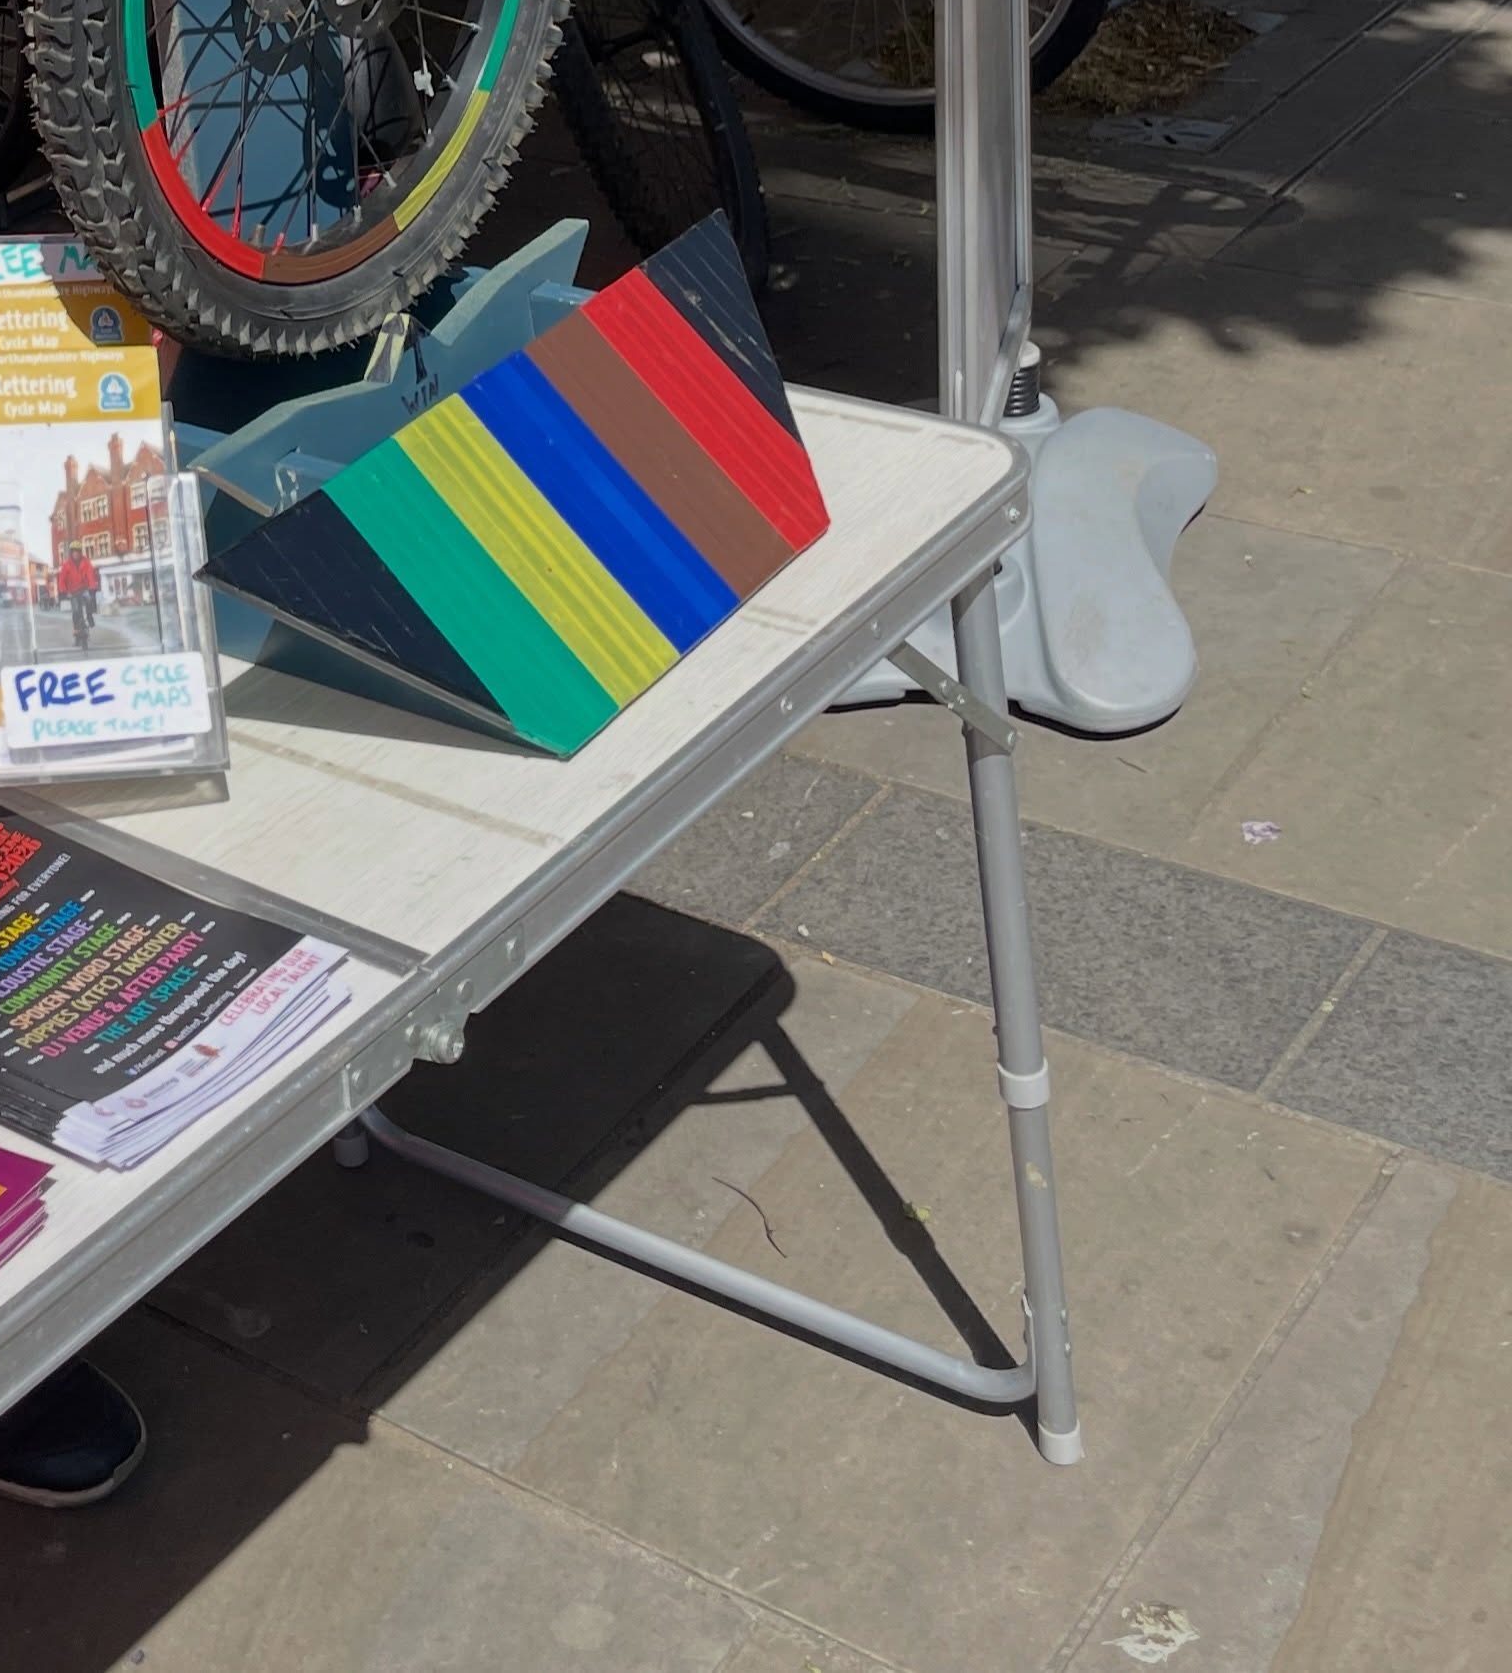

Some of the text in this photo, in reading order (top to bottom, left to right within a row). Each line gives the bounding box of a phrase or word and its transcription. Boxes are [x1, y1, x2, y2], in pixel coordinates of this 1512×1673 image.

[31, 334, 59, 350] Map
[4, 401, 67, 417] Cycle Map
[15, 664, 190, 713] FREE CYCLE
[131, 688, 192, 711] MAPS
[32, 716, 97, 742] PLEASE
[11, 890, 30, 905] FOR
[27, 853, 70, 891] EVERYONE!
[37, 900, 84, 935] STAGE
[45, 919, 93, 954] STAGE
[73, 923, 121, 957] STAGE
[9, 924, 150, 1029] SPOKEN WORD STAGE
[15, 923, 185, 1048] POPPIES (KTFC) TAKEOVER
[39, 931, 203, 1056] DJ VENUE & AFTER PARTY
[218, 968, 287, 1025] CELEBRATING
[281, 948, 307, 966] OUR
[246, 987, 288, 1014] LOCAL
[281, 954, 321, 983] TALENT
[93, 1058, 115, 1073] and
[111, 1042, 141, 1062] much
[136, 1024, 165, 1044] more
[158, 981, 213, 1024] throughout
[205, 968, 228, 982] the
[222, 951, 246, 969] day!
[94, 965, 197, 1043] THE ART SPACE
